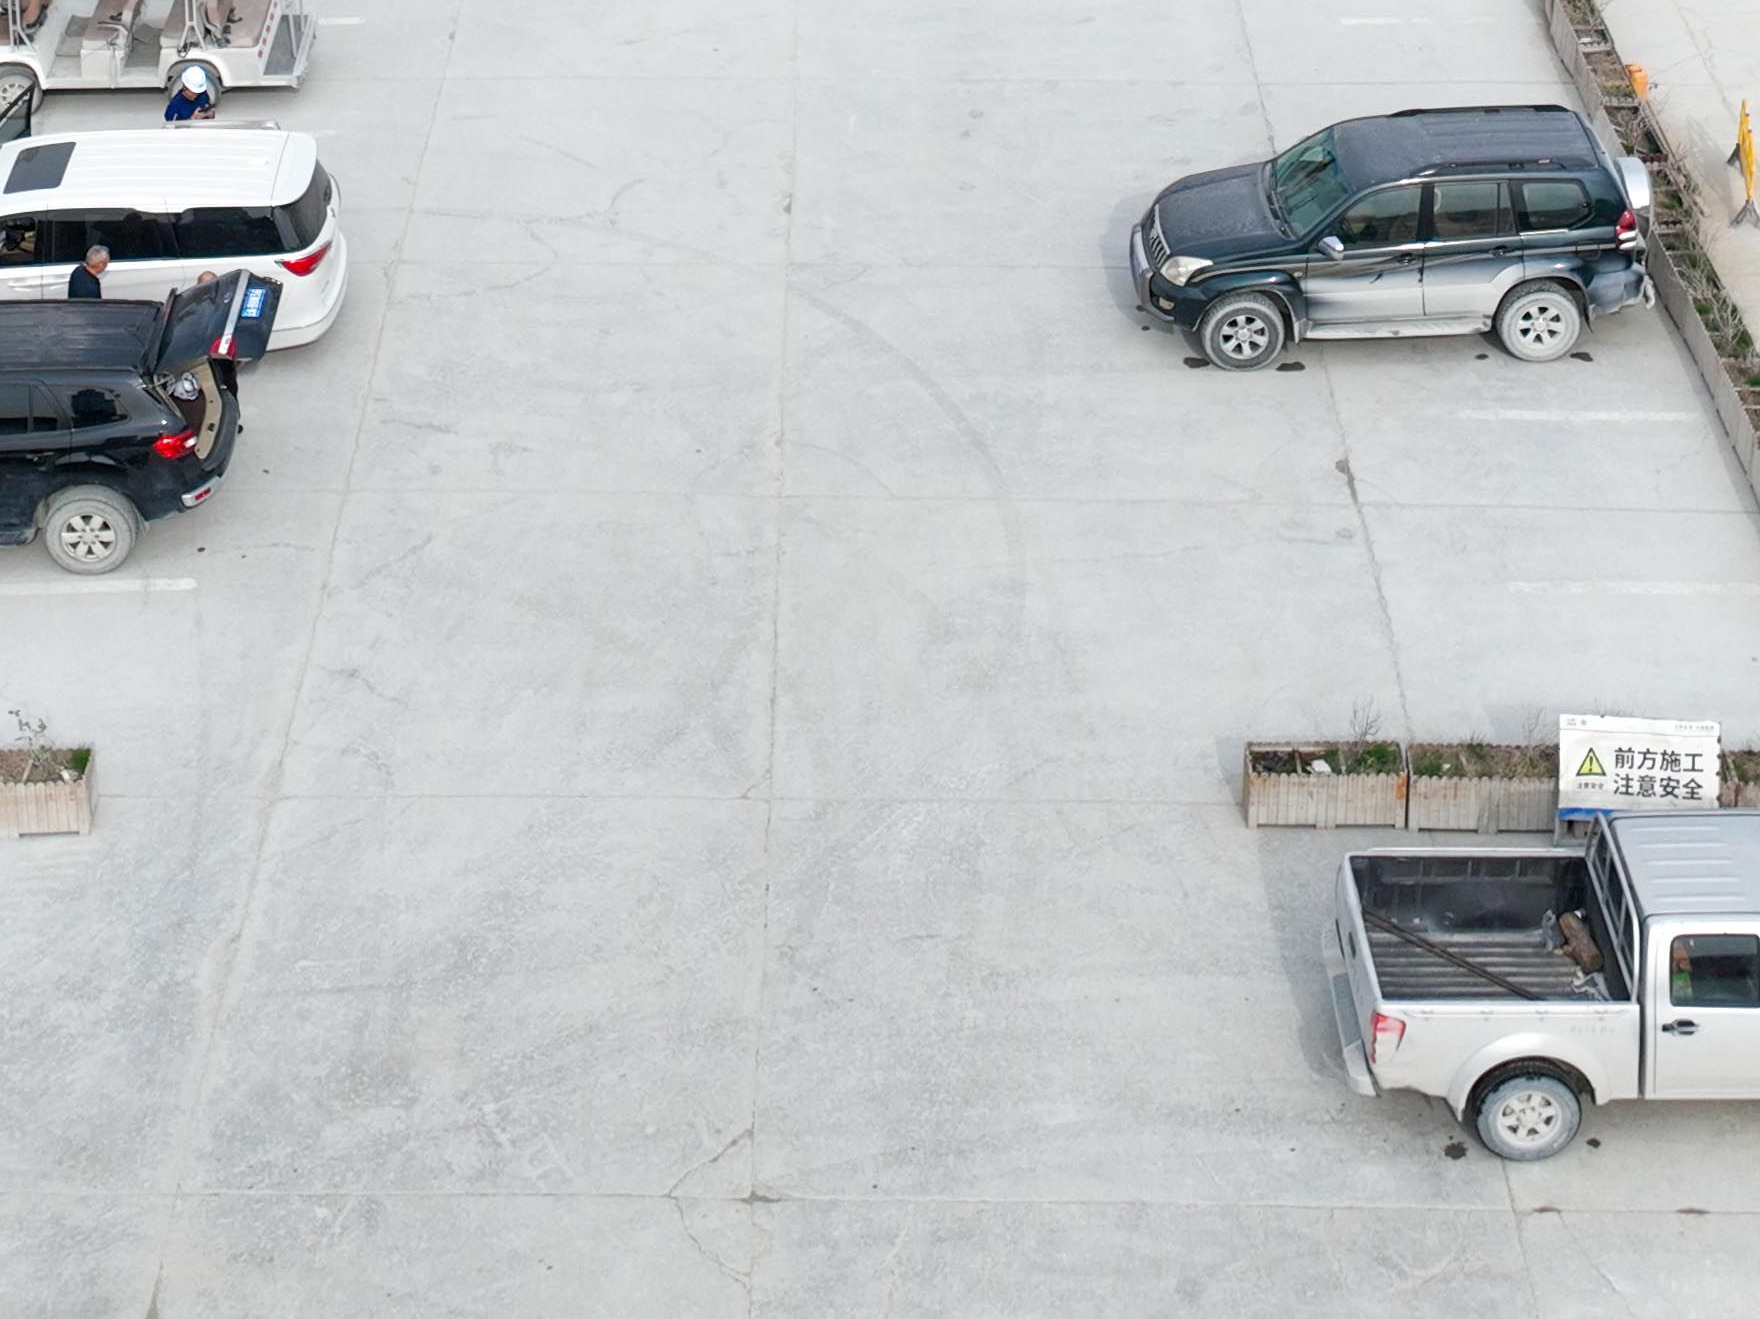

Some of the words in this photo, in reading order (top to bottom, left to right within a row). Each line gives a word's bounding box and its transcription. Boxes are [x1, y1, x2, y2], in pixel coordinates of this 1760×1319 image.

[1614, 747, 1704, 773] 前方施工
[1614, 774, 1703, 801] 注意安全
